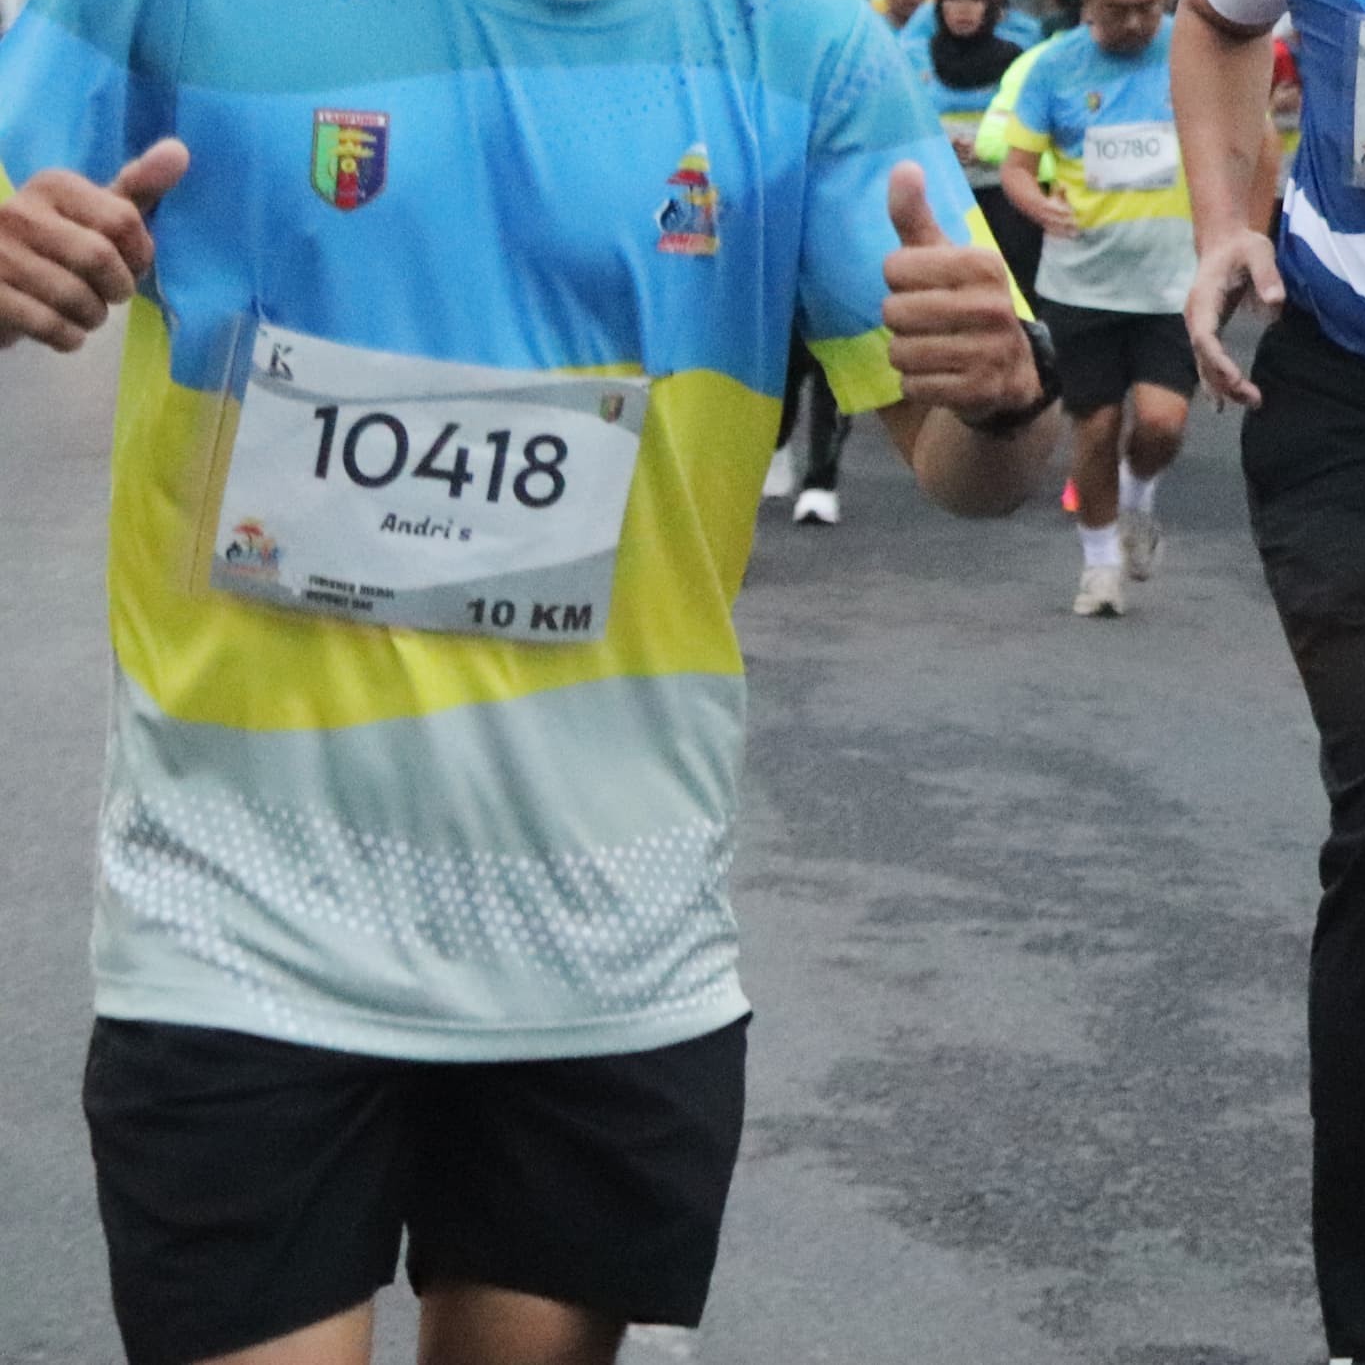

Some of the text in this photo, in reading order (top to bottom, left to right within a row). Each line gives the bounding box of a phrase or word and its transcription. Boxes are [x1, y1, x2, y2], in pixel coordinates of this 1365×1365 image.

[1095, 138, 1161, 159] 10780
[313, 405, 568, 509] 10418
[380, 512, 451, 541] Andri
[466, 598, 593, 632] 10 KM
